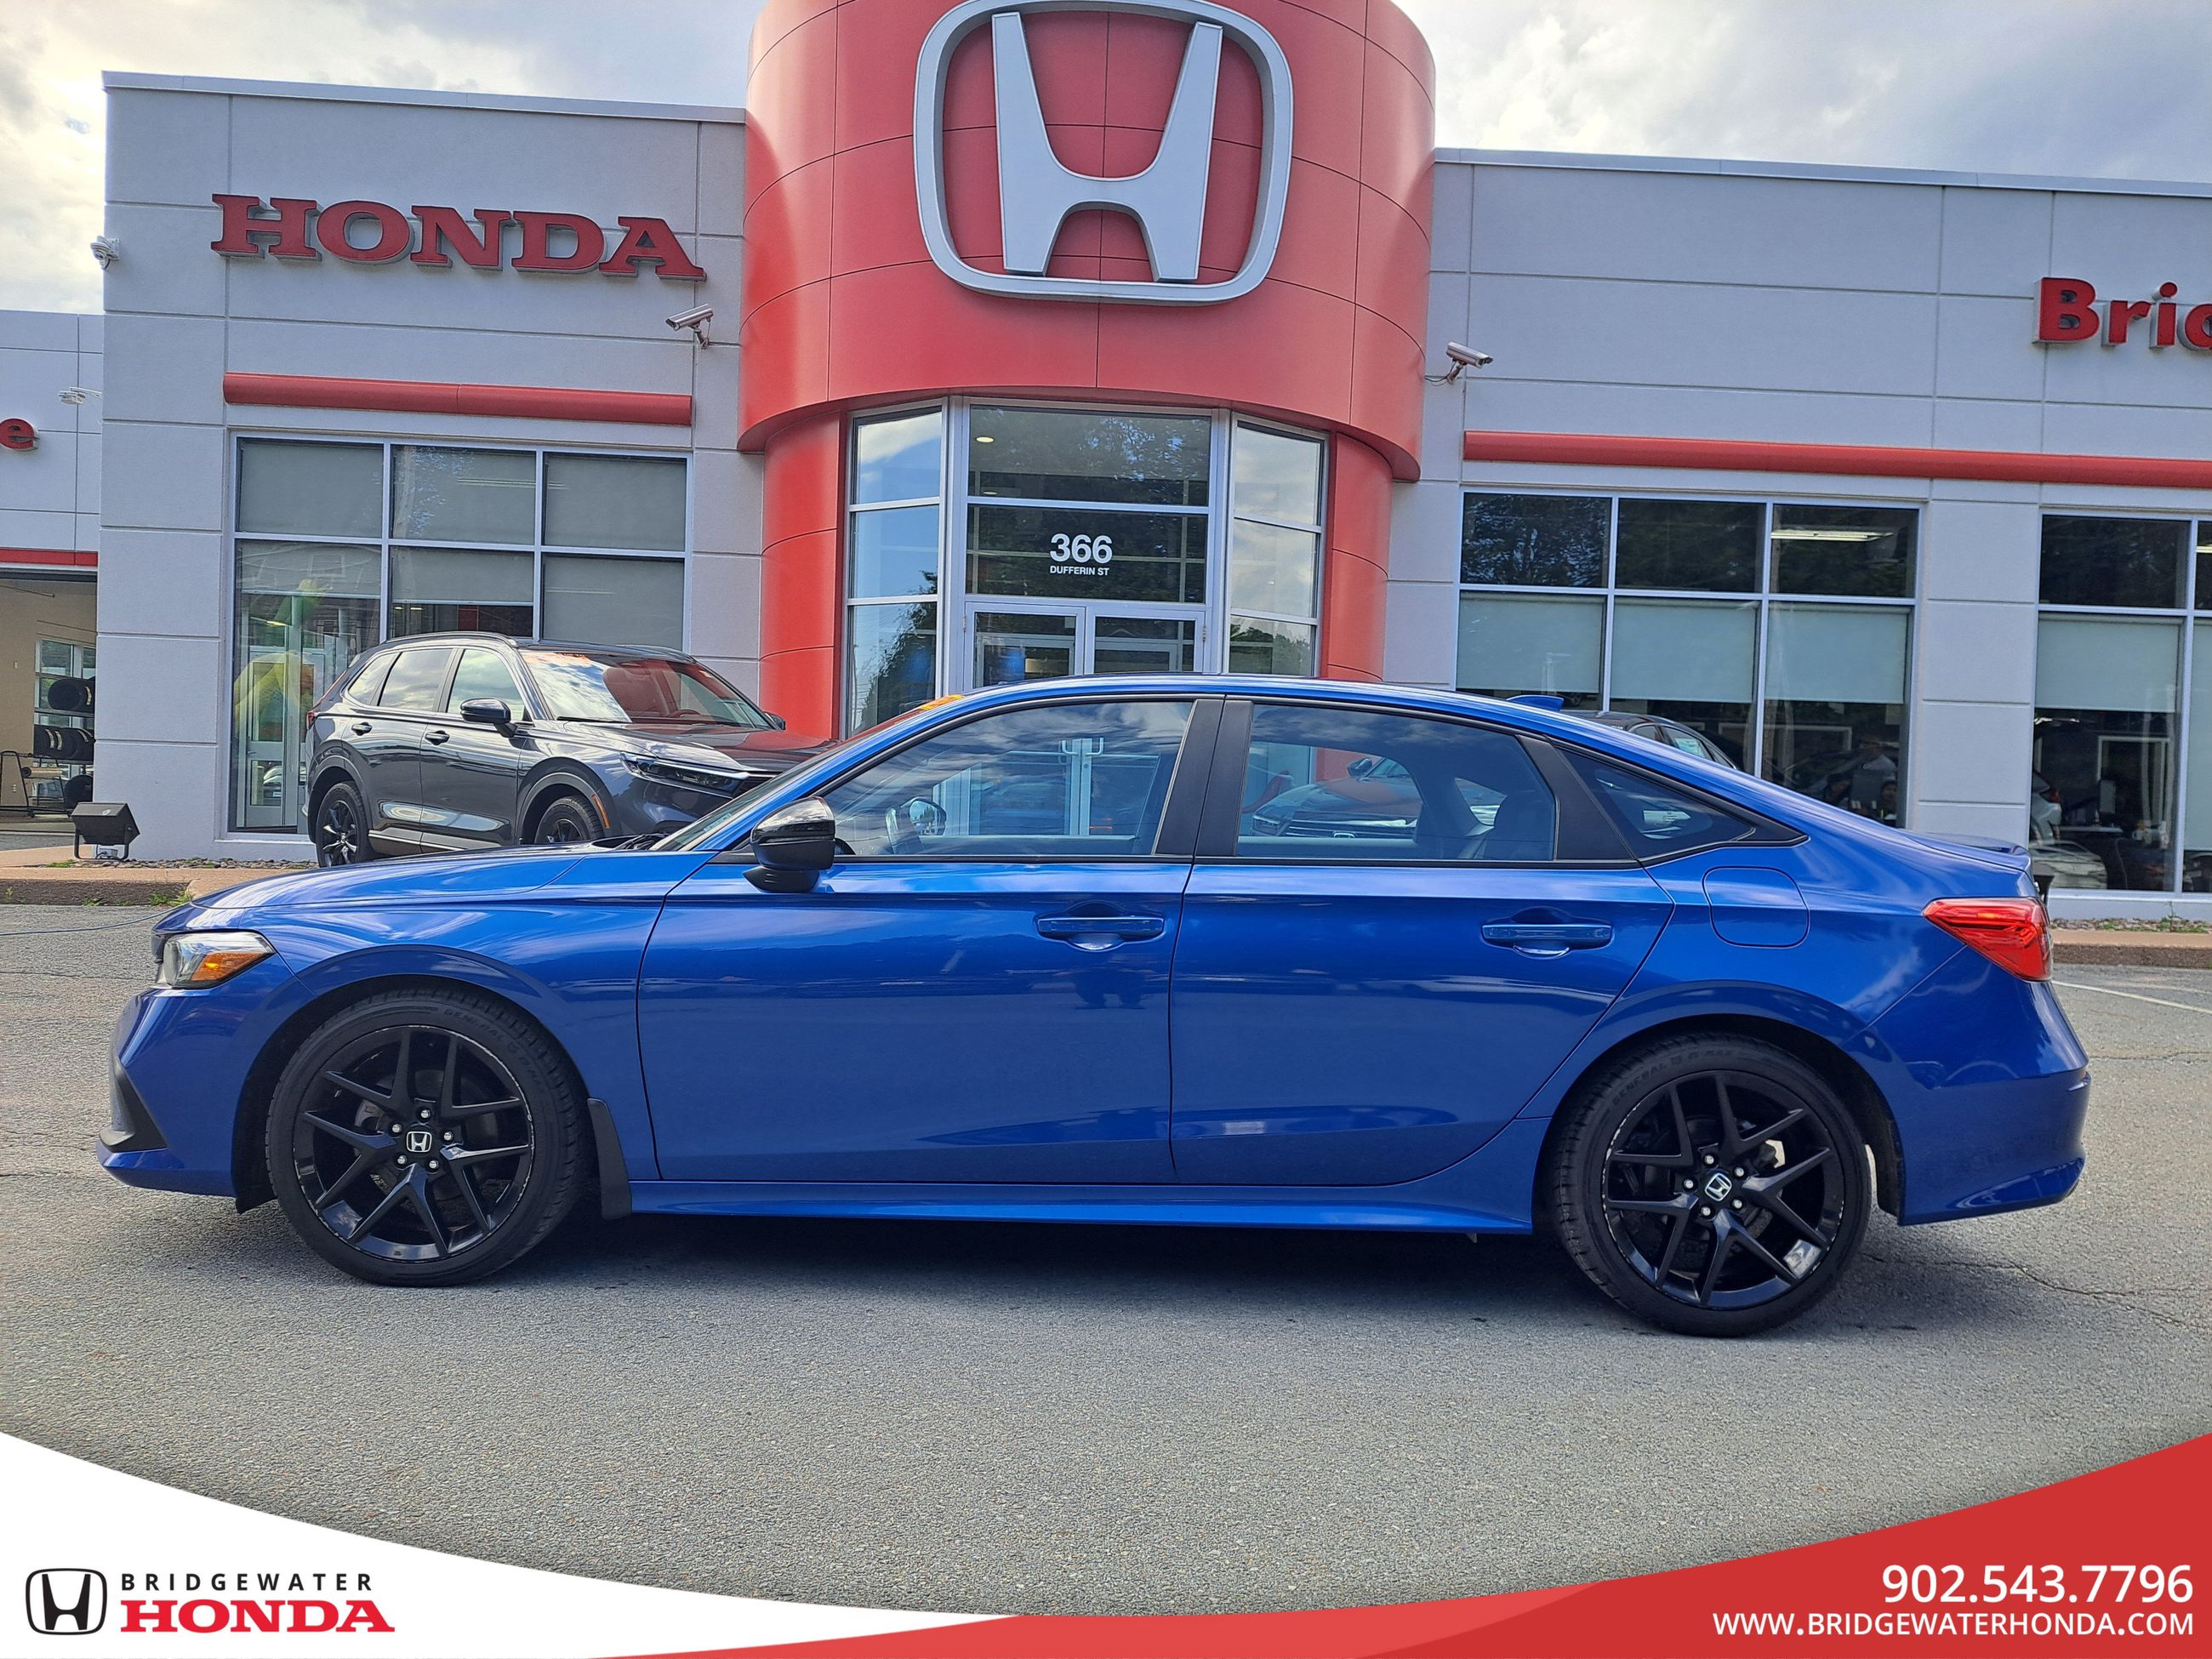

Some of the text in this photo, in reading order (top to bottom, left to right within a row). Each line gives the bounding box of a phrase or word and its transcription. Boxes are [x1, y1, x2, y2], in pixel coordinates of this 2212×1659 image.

[210, 192, 707, 282] HONDA
[1050, 533, 1113, 563] 366
[1050, 565, 1109, 576] DUFFERIN ST
